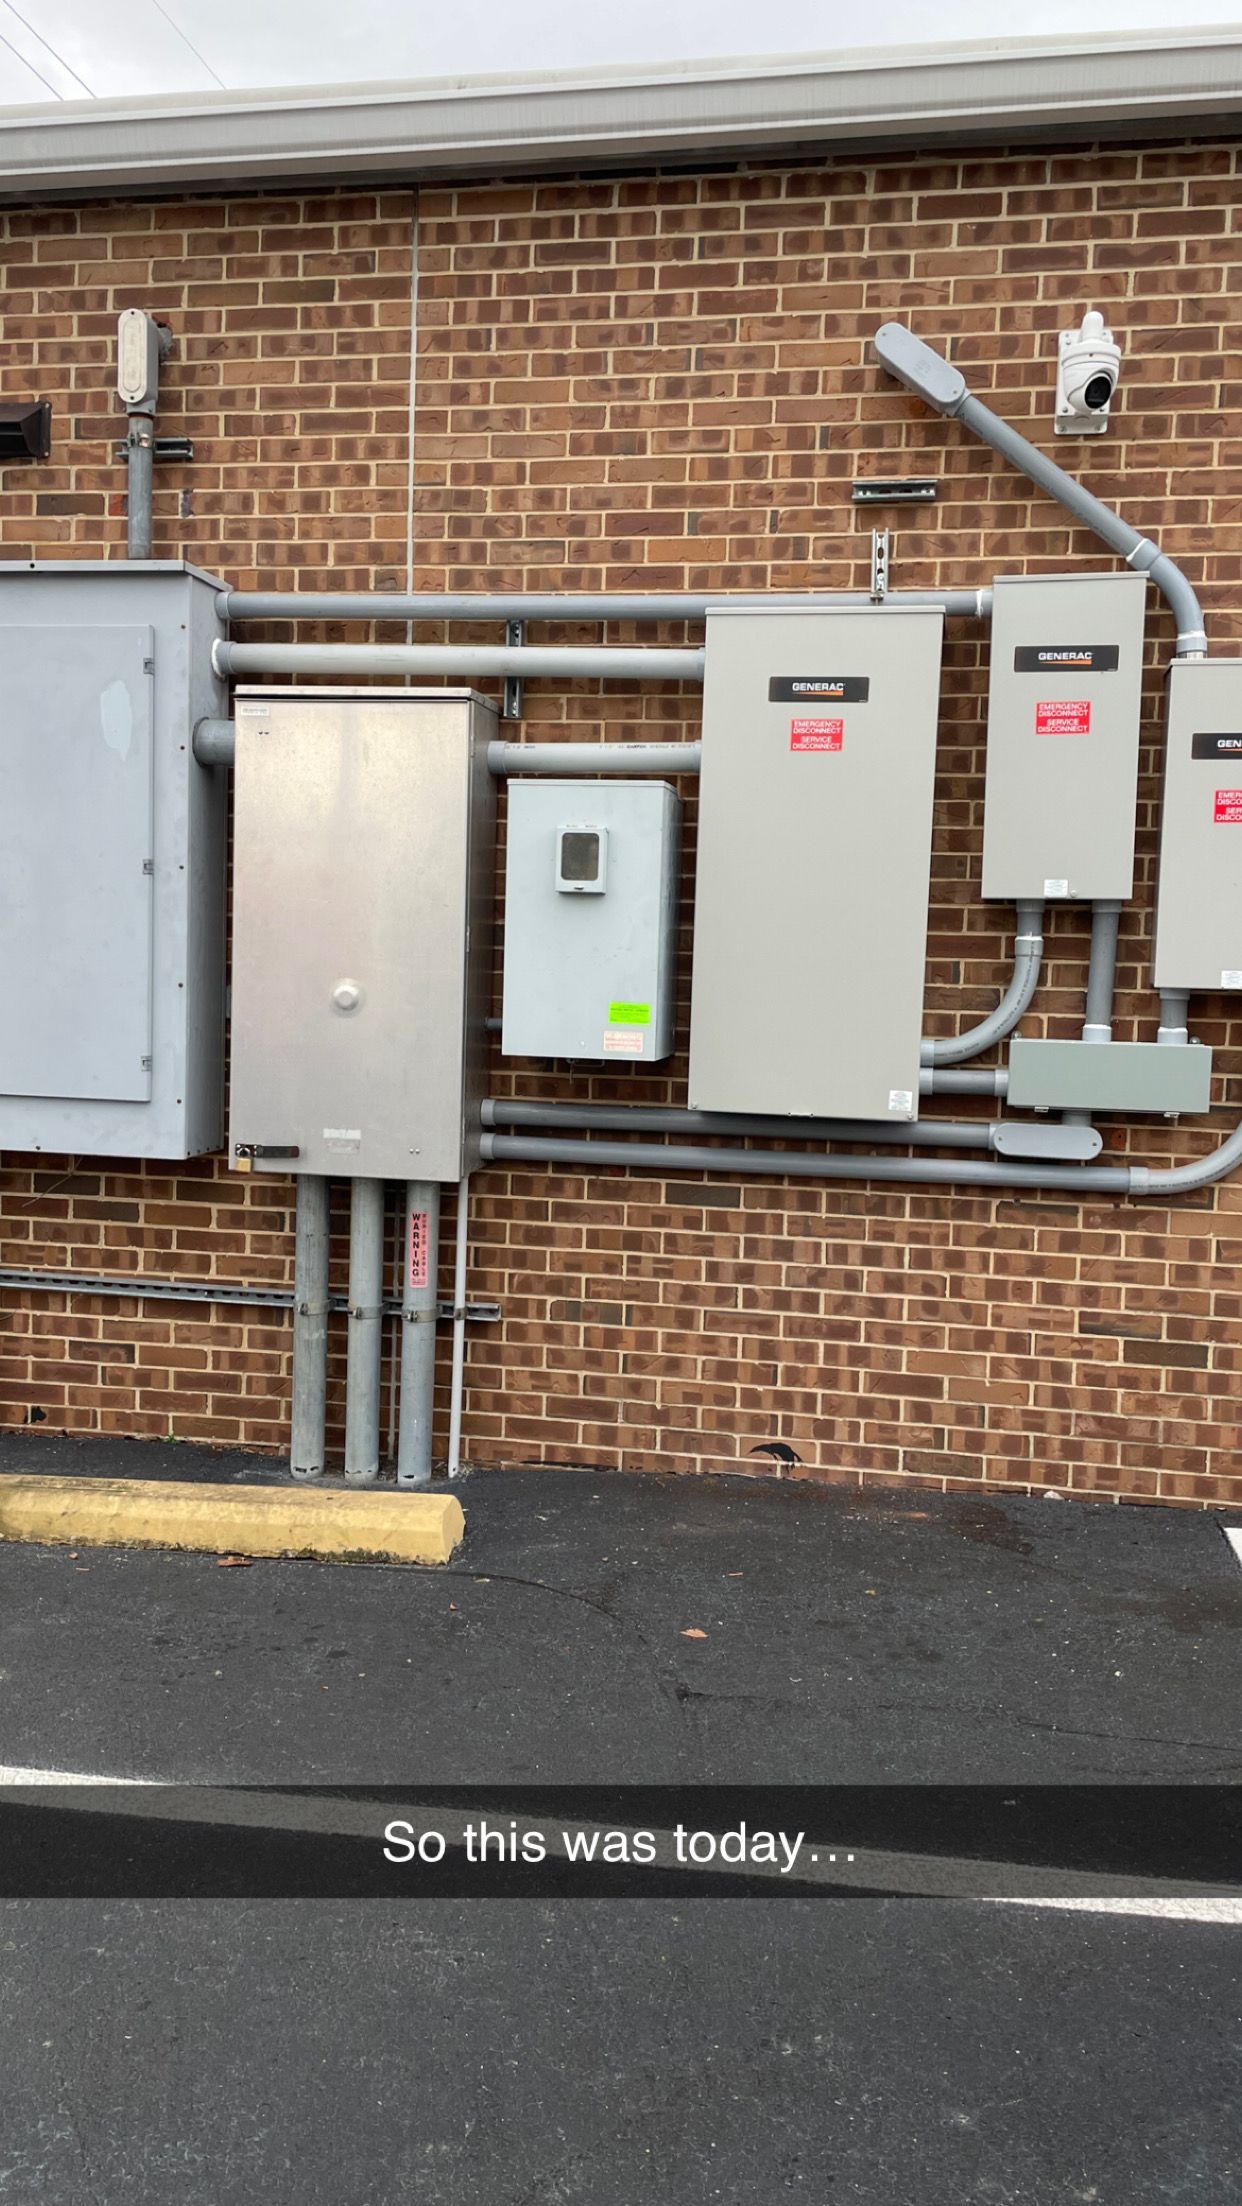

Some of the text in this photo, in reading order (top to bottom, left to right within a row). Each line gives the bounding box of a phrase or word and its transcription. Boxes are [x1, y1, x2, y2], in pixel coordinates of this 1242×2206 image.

[1038, 652, 1092, 661] GENERAC
[792, 682, 844, 691] GENERAC
[794, 720, 842, 728] EMERGENCY
[1047, 718, 1078, 726] SERVICE
[1038, 725, 1088, 733] DISCONNECT
[801, 735, 832, 743] SERVICE
[792, 742, 841, 750] DISCONNECT
[412, 1213, 420, 1276] WARNING
